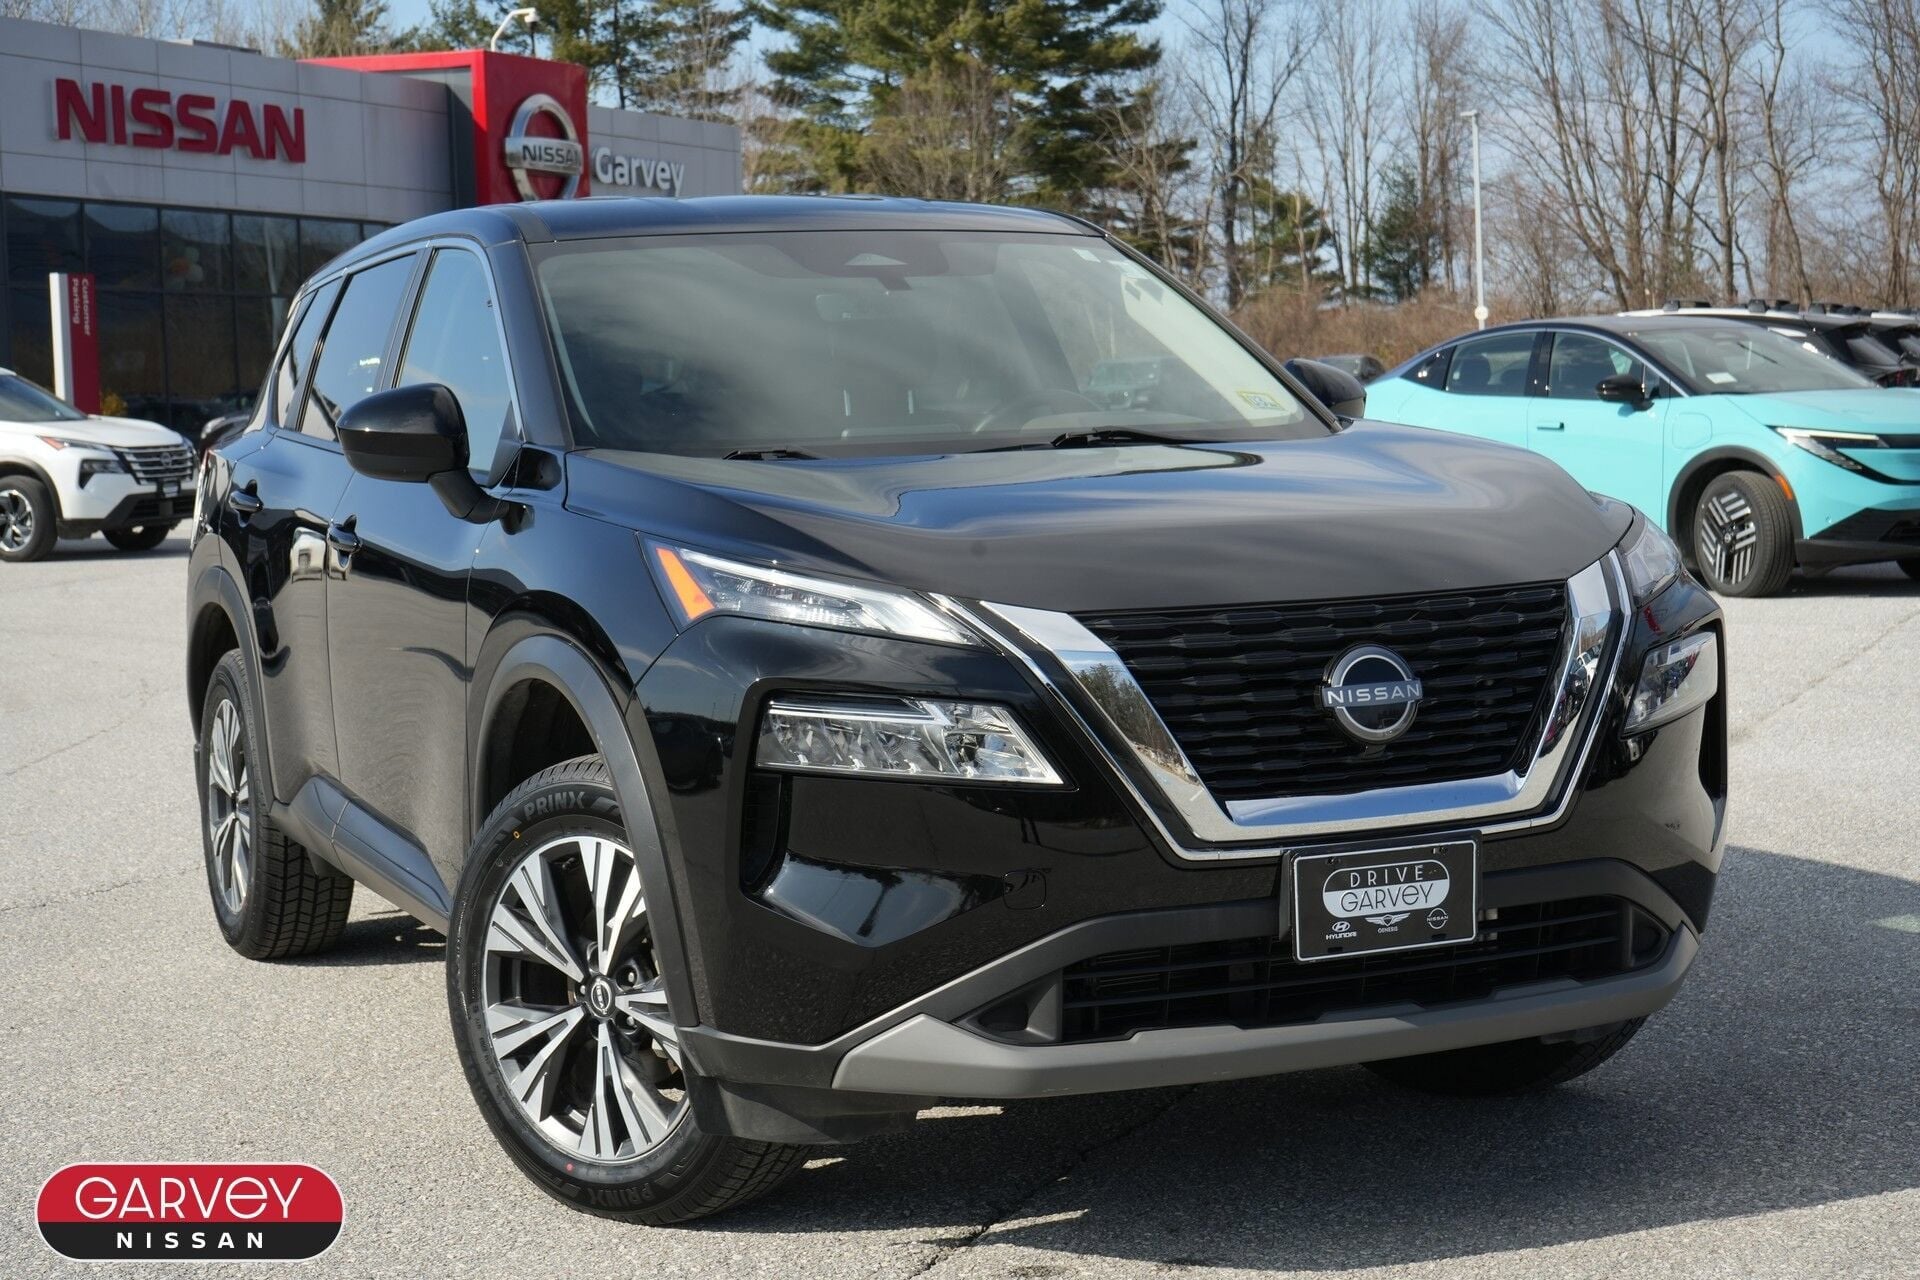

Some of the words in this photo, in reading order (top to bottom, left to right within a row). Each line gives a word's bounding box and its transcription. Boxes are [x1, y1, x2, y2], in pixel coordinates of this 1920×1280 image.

[56, 78, 306, 163] NISSAN
[595, 147, 685, 198] Garvey
[72, 277, 81, 325] Parking
[82, 277, 91, 336] Customer
[1327, 684, 1420, 704] NISSAN
[523, 791, 586, 820] PRINX
[1350, 865, 1424, 888] DRIVE
[1377, 925, 1398, 934] GENESIS
[1427, 914, 1449, 922] NISSAN
[1326, 931, 1357, 940] HYUNDAI
